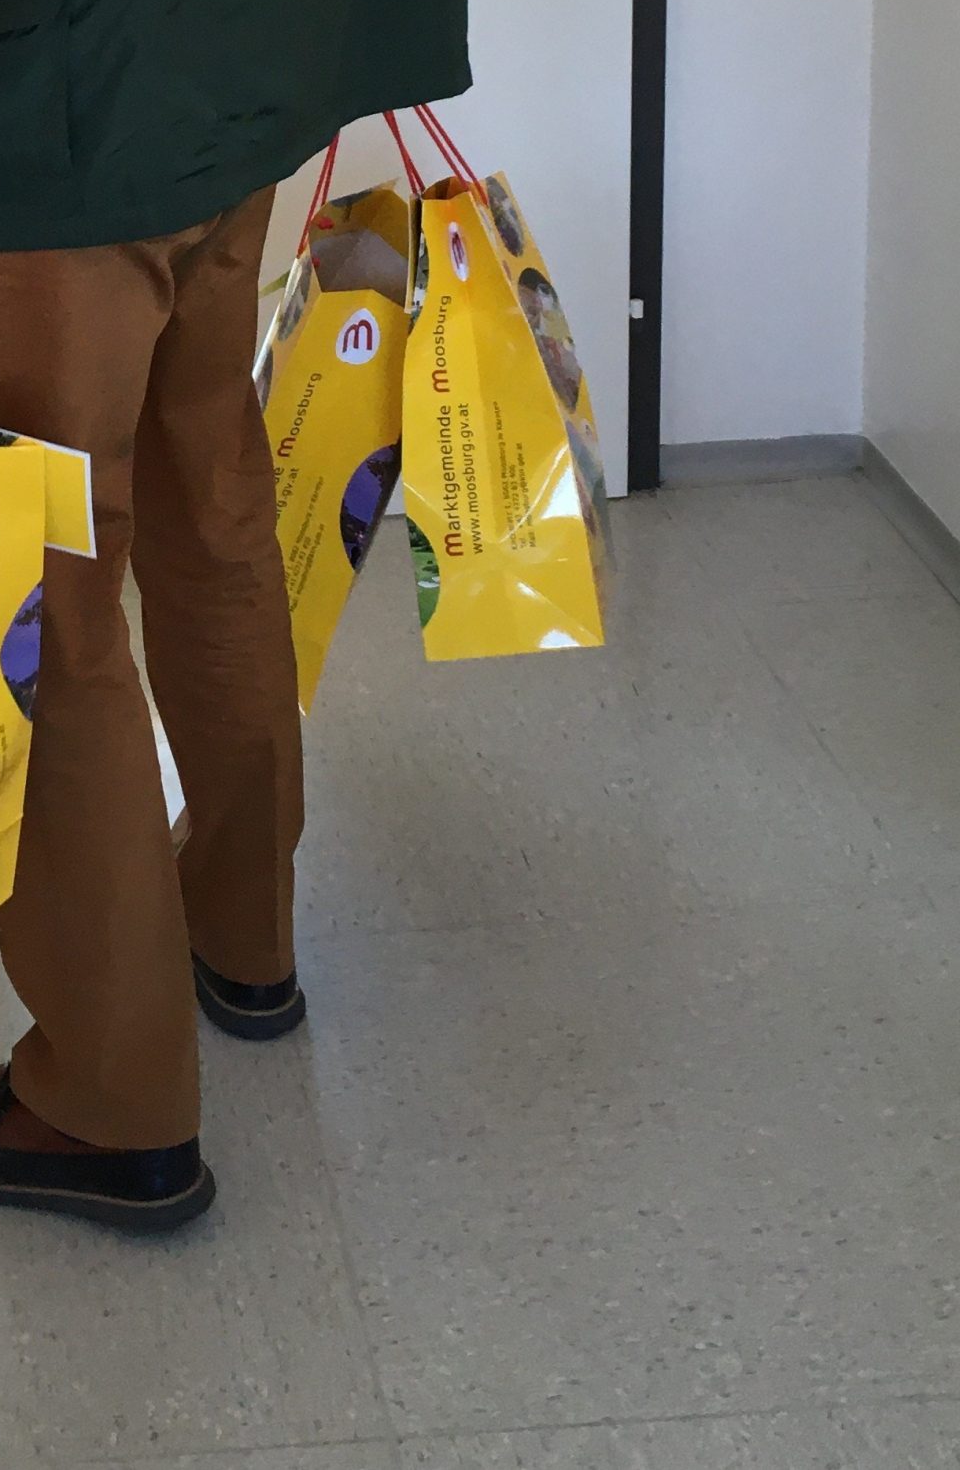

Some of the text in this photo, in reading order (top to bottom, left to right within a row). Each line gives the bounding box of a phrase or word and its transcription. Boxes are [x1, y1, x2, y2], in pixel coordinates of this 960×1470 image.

[342, 319, 373, 353] m
[277, 372, 323, 458] moosburg
[431, 295, 464, 557] marktgemeinde moosburg
[458, 403, 483, 555] www.moosburg.gv.at
